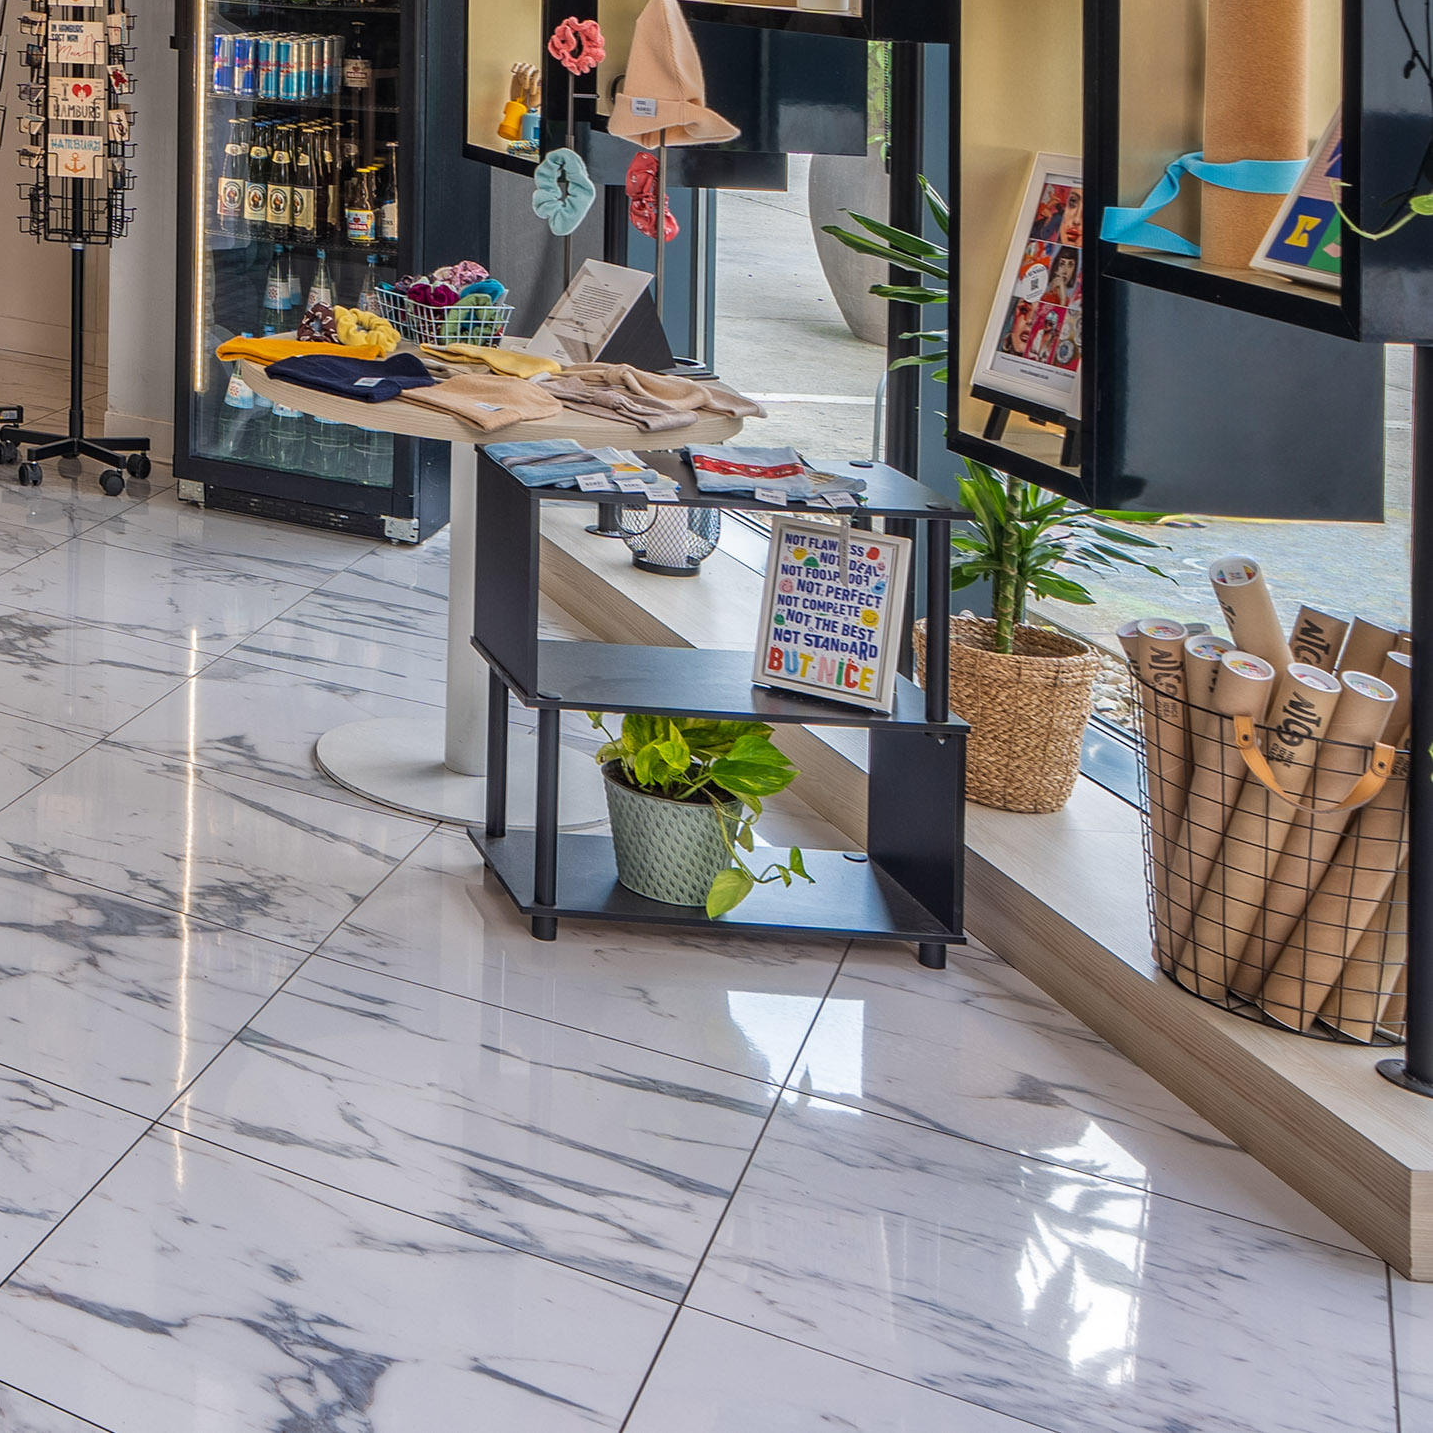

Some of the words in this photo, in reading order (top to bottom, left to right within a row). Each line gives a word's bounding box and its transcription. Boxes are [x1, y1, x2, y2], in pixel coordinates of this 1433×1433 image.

[52, 104, 102, 119] HAMBURG
[784, 532, 807, 547] NOT
[808, 537, 865, 557] FLAWSS
[781, 564, 804, 577] NOT
[805, 568, 870, 586] FOOLPOOF
[848, 560, 881, 577] DEAL
[777, 594, 800, 608] NOT
[802, 598, 861, 617] COMPLETE
[796, 579, 821, 594] NOT
[825, 585, 883, 609] PERFECT
[785, 609, 811, 627] NOT
[814, 616, 839, 633] THE
[841, 624, 876, 643] BEST
[773, 627, 801, 645] NOT
[803, 633, 879, 661] STANDARD
[767, 645, 815, 678] BUT
[816, 656, 875, 693] NICE
